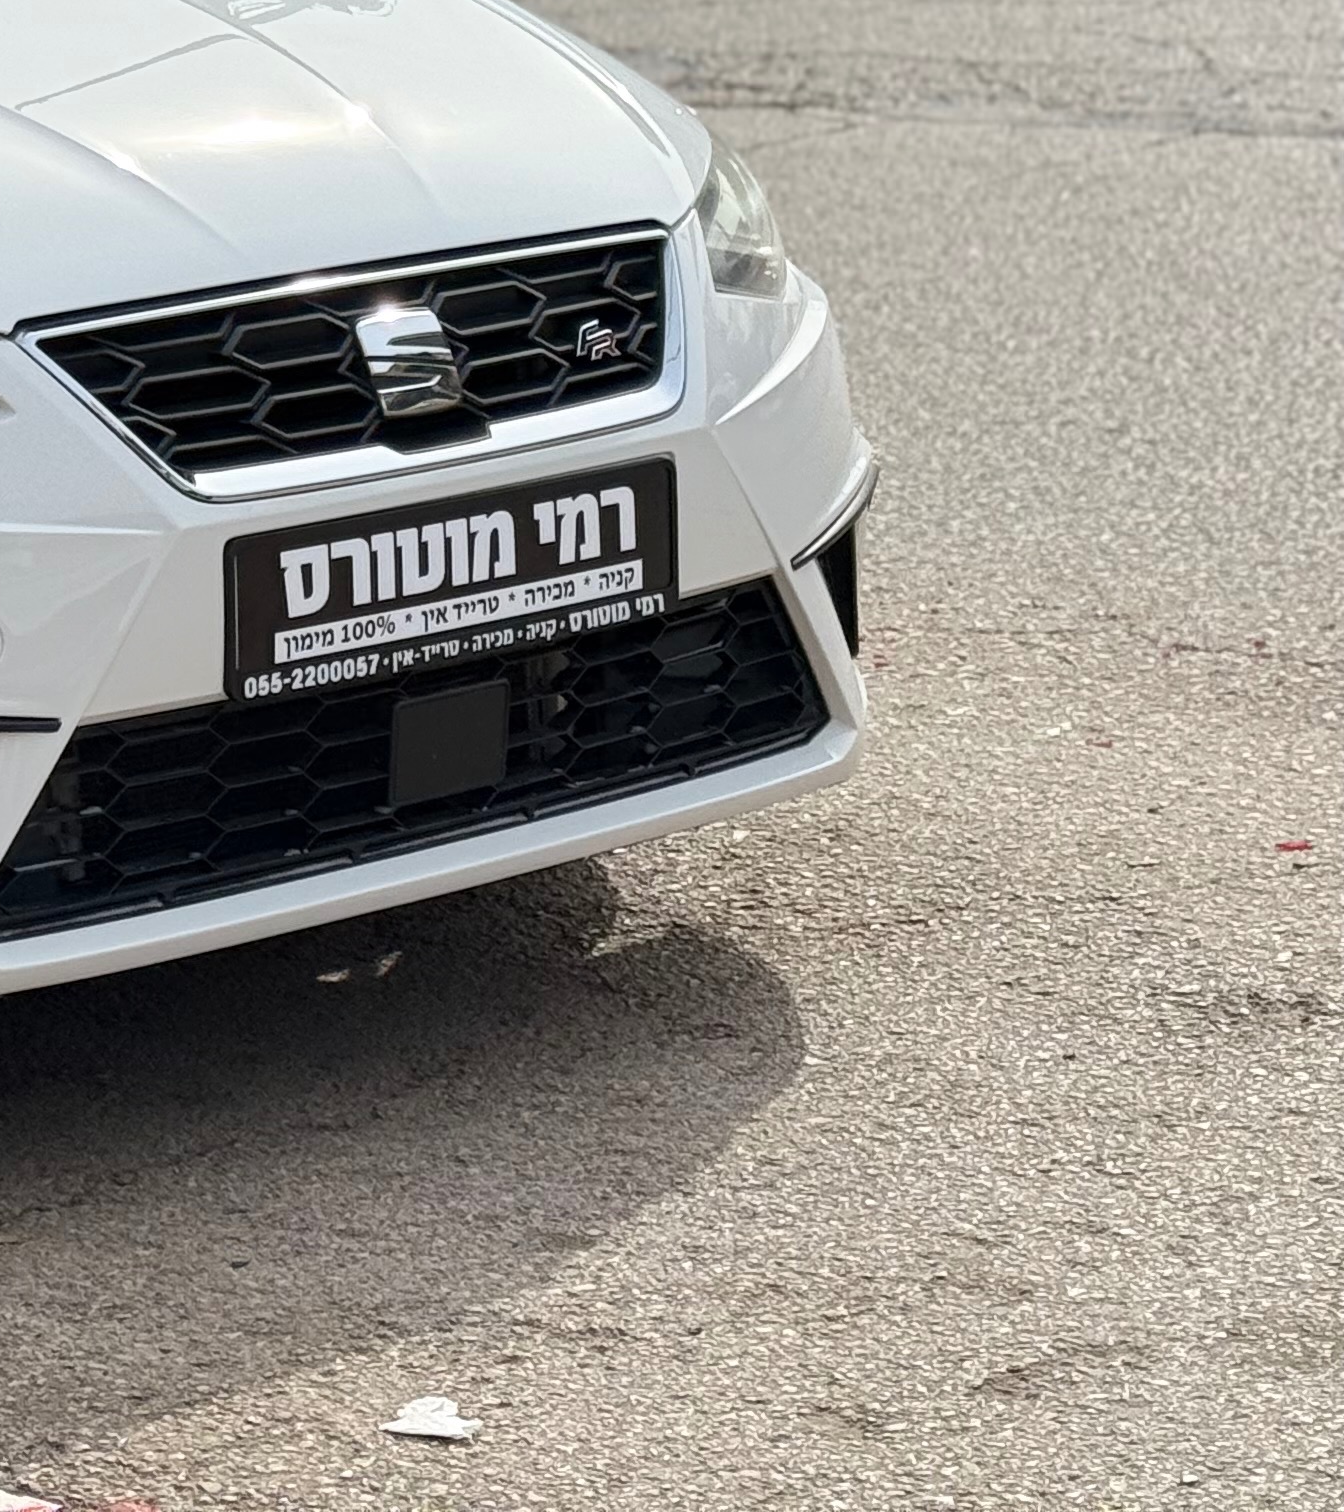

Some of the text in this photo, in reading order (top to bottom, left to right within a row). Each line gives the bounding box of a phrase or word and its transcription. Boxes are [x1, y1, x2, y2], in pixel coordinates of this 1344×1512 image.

[576, 318, 622, 361] FR
[279, 486, 637, 619] רמי מוטורס
[283, 566, 635, 660] קניה מכירה טרייד אין 100% מימון
[568, 600, 631, 633] מוטורס
[635, 593, 666, 617] רמי
[471, 628, 514, 653] מכירה
[525, 618, 557, 642] קניה
[243, 653, 381, 700] 055-2200057
